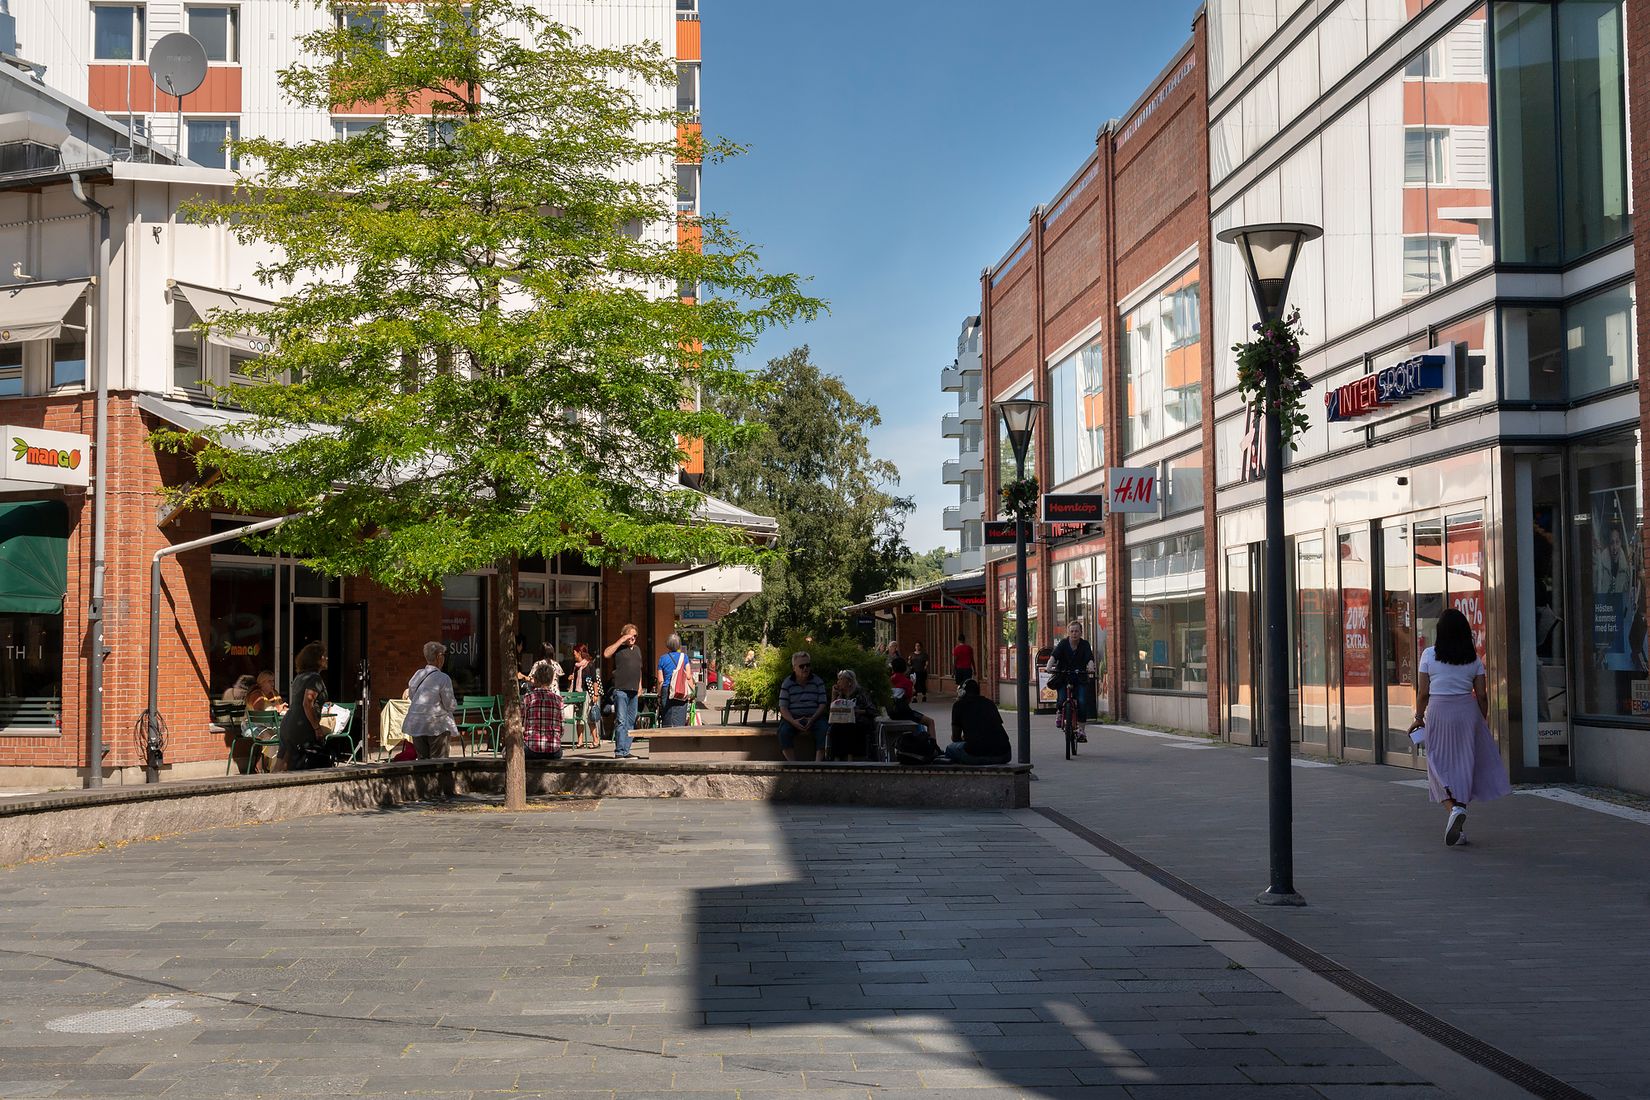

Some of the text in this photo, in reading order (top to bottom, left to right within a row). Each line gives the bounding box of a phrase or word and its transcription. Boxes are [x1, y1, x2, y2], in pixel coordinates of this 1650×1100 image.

[1114, 476, 1154, 504] H&M
[1049, 502, 1098, 514] Hemköp
[1346, 607, 1366, 629] 20%
